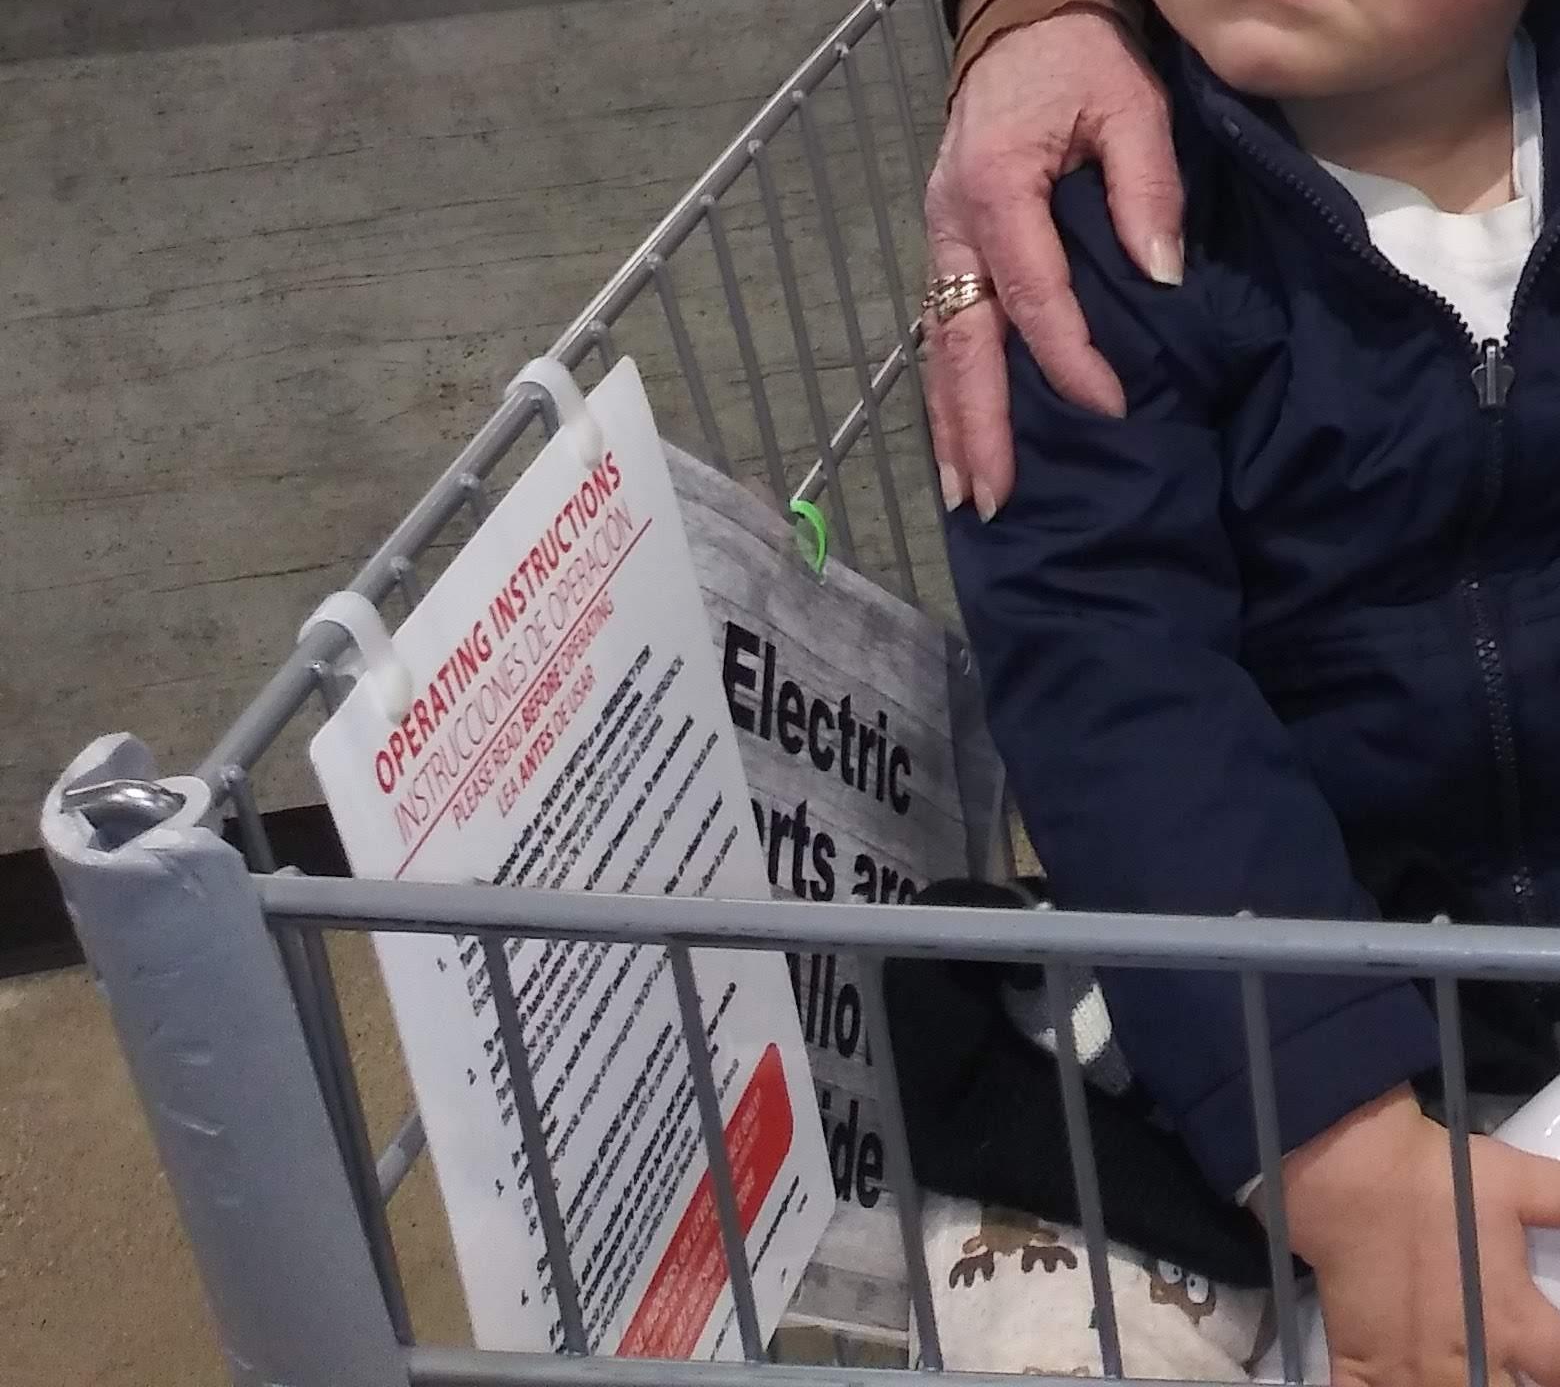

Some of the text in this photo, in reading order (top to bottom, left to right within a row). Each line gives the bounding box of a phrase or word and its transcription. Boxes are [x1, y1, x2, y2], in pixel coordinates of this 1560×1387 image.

[371, 445, 621, 800] OPERATING INSTRUCTIONS
[392, 635, 529, 849] INSTRUCCIONES
[522, 603, 552, 670] DE
[452, 588, 614, 832] PLEASE READ BEFORE OPERATING
[723, 621, 911, 815] Electric
[751, 798, 836, 902] rts
